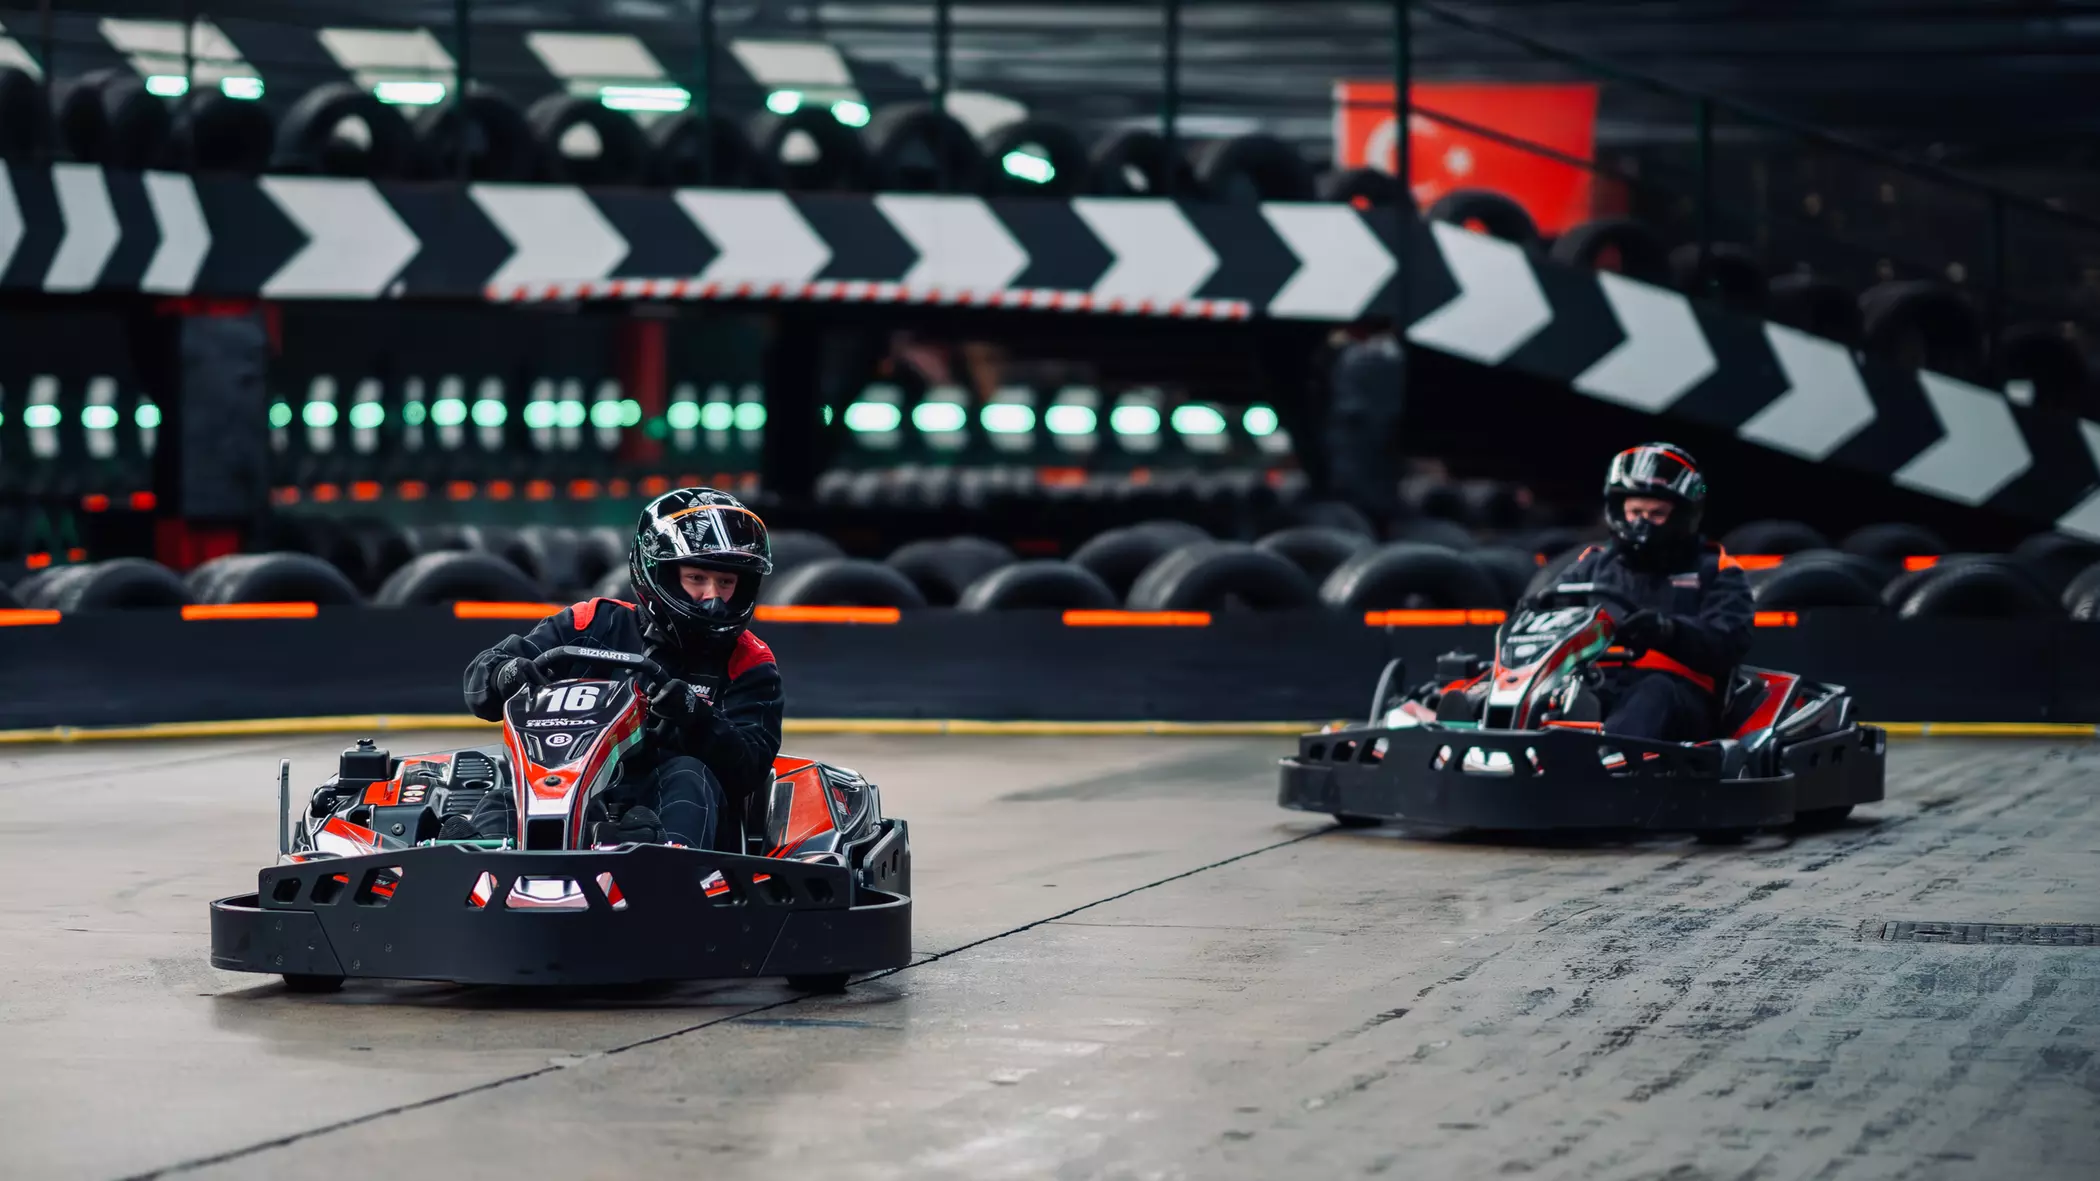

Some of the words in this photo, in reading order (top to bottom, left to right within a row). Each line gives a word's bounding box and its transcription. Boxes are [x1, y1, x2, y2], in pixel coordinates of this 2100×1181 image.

[579, 648, 630, 661] BIZKARTS
[546, 686, 600, 712] 16
[525, 719, 598, 728] HONDA
